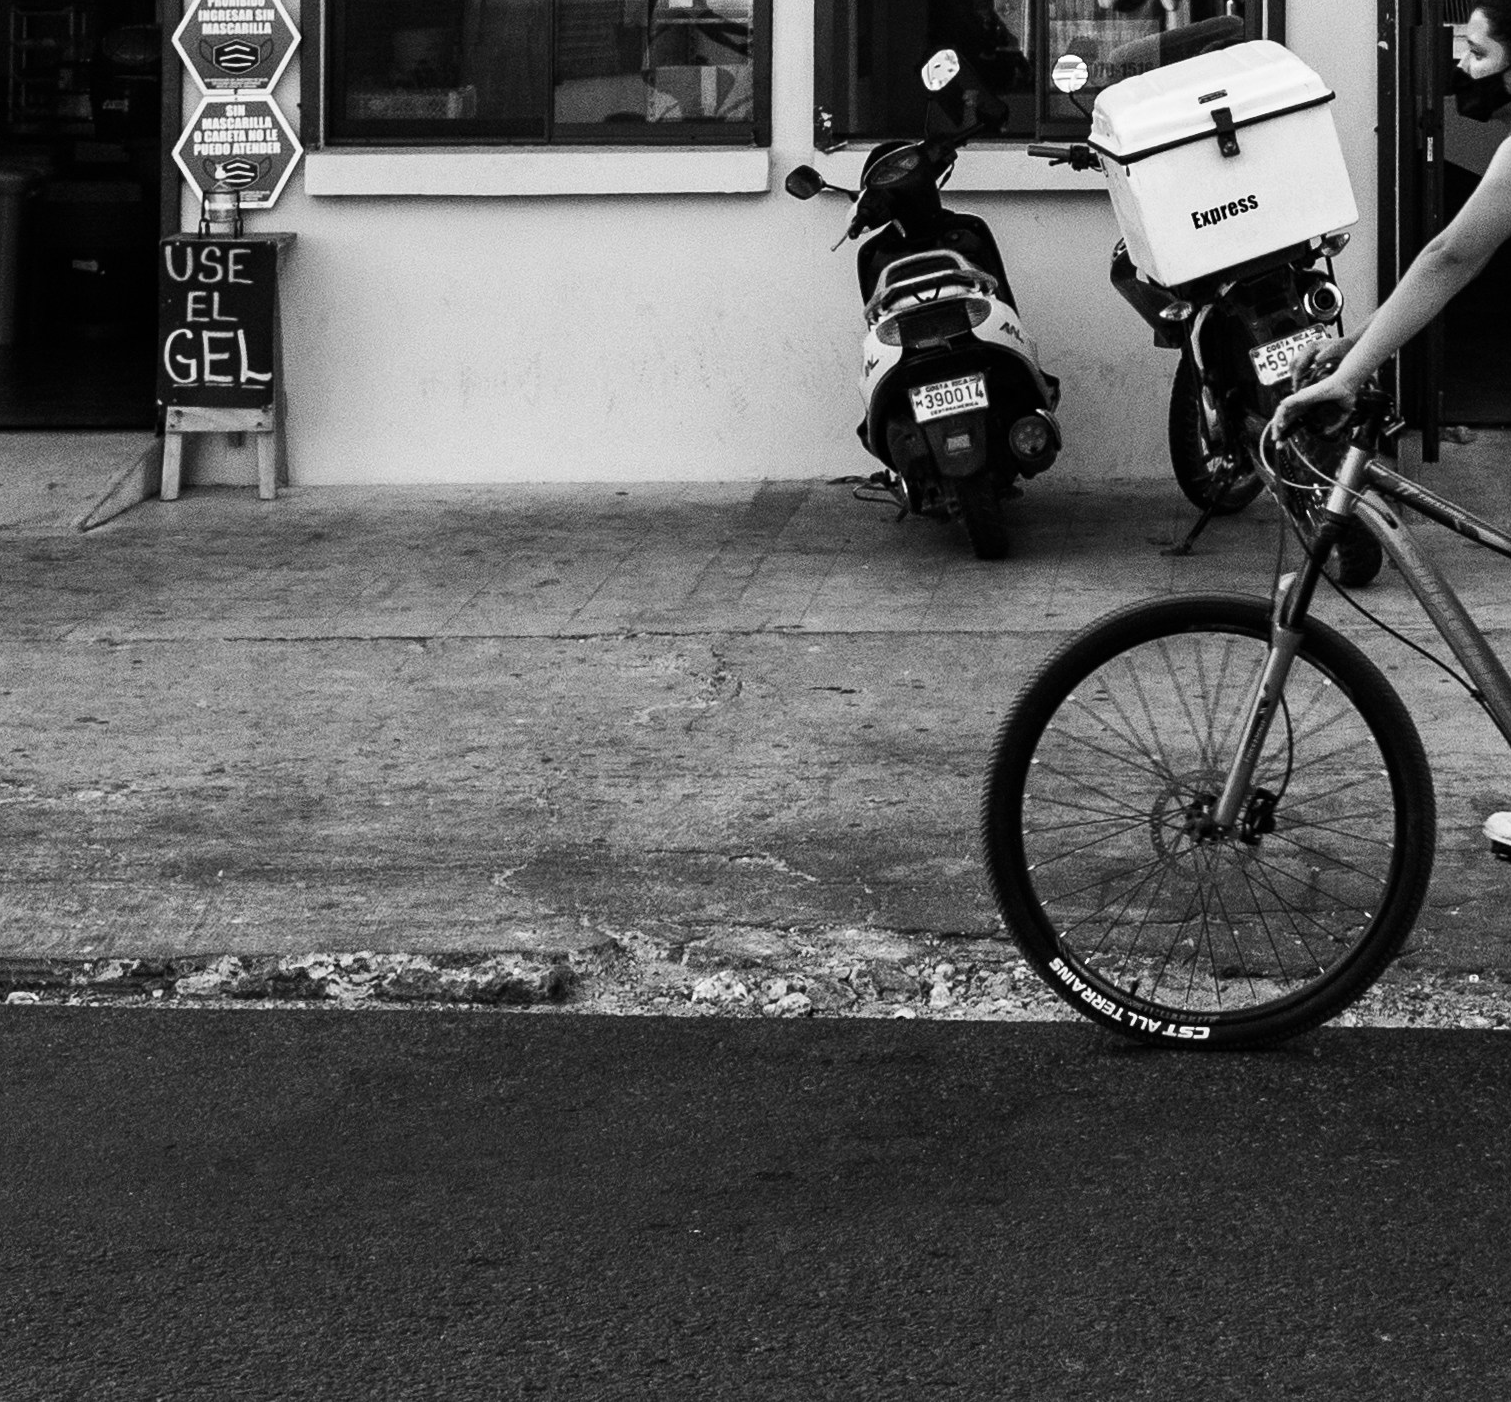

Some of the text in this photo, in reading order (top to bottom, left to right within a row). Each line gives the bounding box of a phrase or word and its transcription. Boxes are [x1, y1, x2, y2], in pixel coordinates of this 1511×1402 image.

[198, 8, 275, 22] INGRESAR SIN
[202, 22, 272, 35] MASCARILLA
[225, 104, 246, 116] SIN
[201, 116, 273, 130] MASCARILLA
[193, 129, 278, 142] O CARETA NO LE
[193, 141, 281, 156] PUEDO ATENDER
[1190, 192, 1259, 230] Express
[165, 245, 254, 284] USE
[187, 291, 239, 322] EL
[164, 328, 272, 384] GEL
[924, 381, 984, 410] 390014
[1049, 956, 1211, 1040] CST ALL TERRAINS
